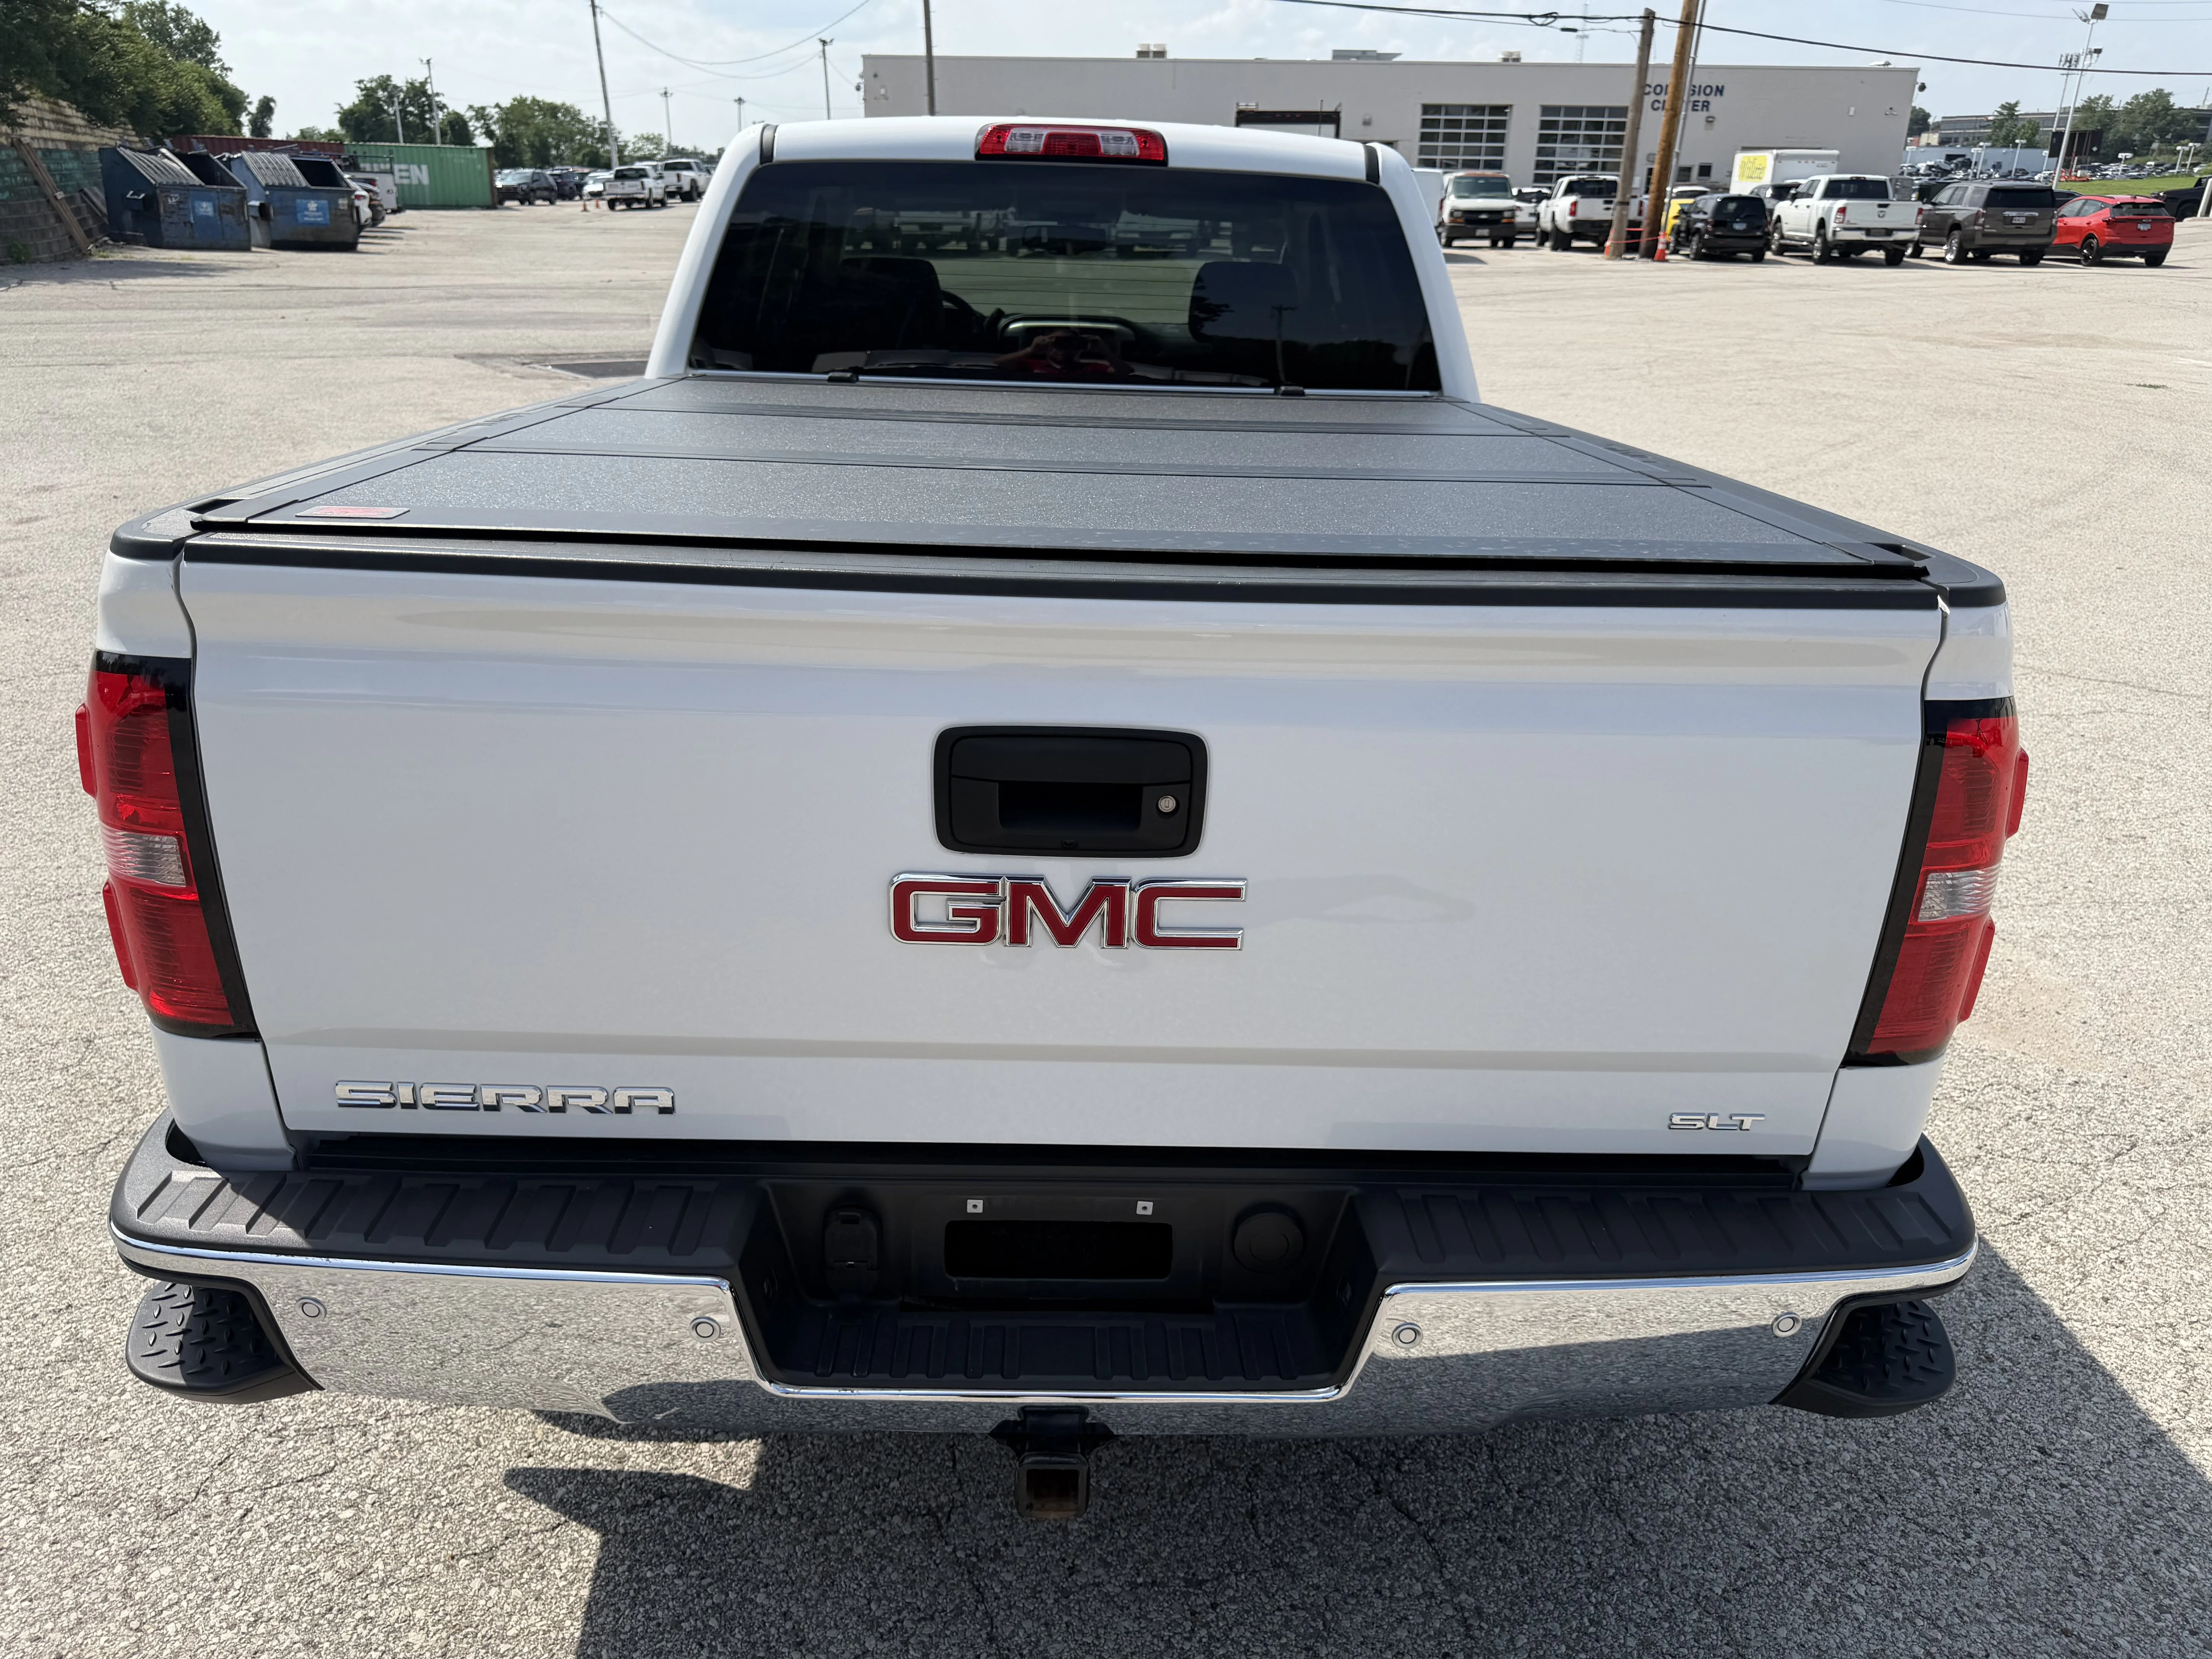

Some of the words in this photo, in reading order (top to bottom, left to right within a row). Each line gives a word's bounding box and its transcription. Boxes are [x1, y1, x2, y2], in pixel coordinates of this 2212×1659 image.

[1644, 84, 1724, 97] COSION
[1651, 100, 1710, 112] CER
[889, 871, 1247, 950] GMC
[335, 1080, 676, 1115] SIERRA
[1668, 1112, 1765, 1131] SLT
